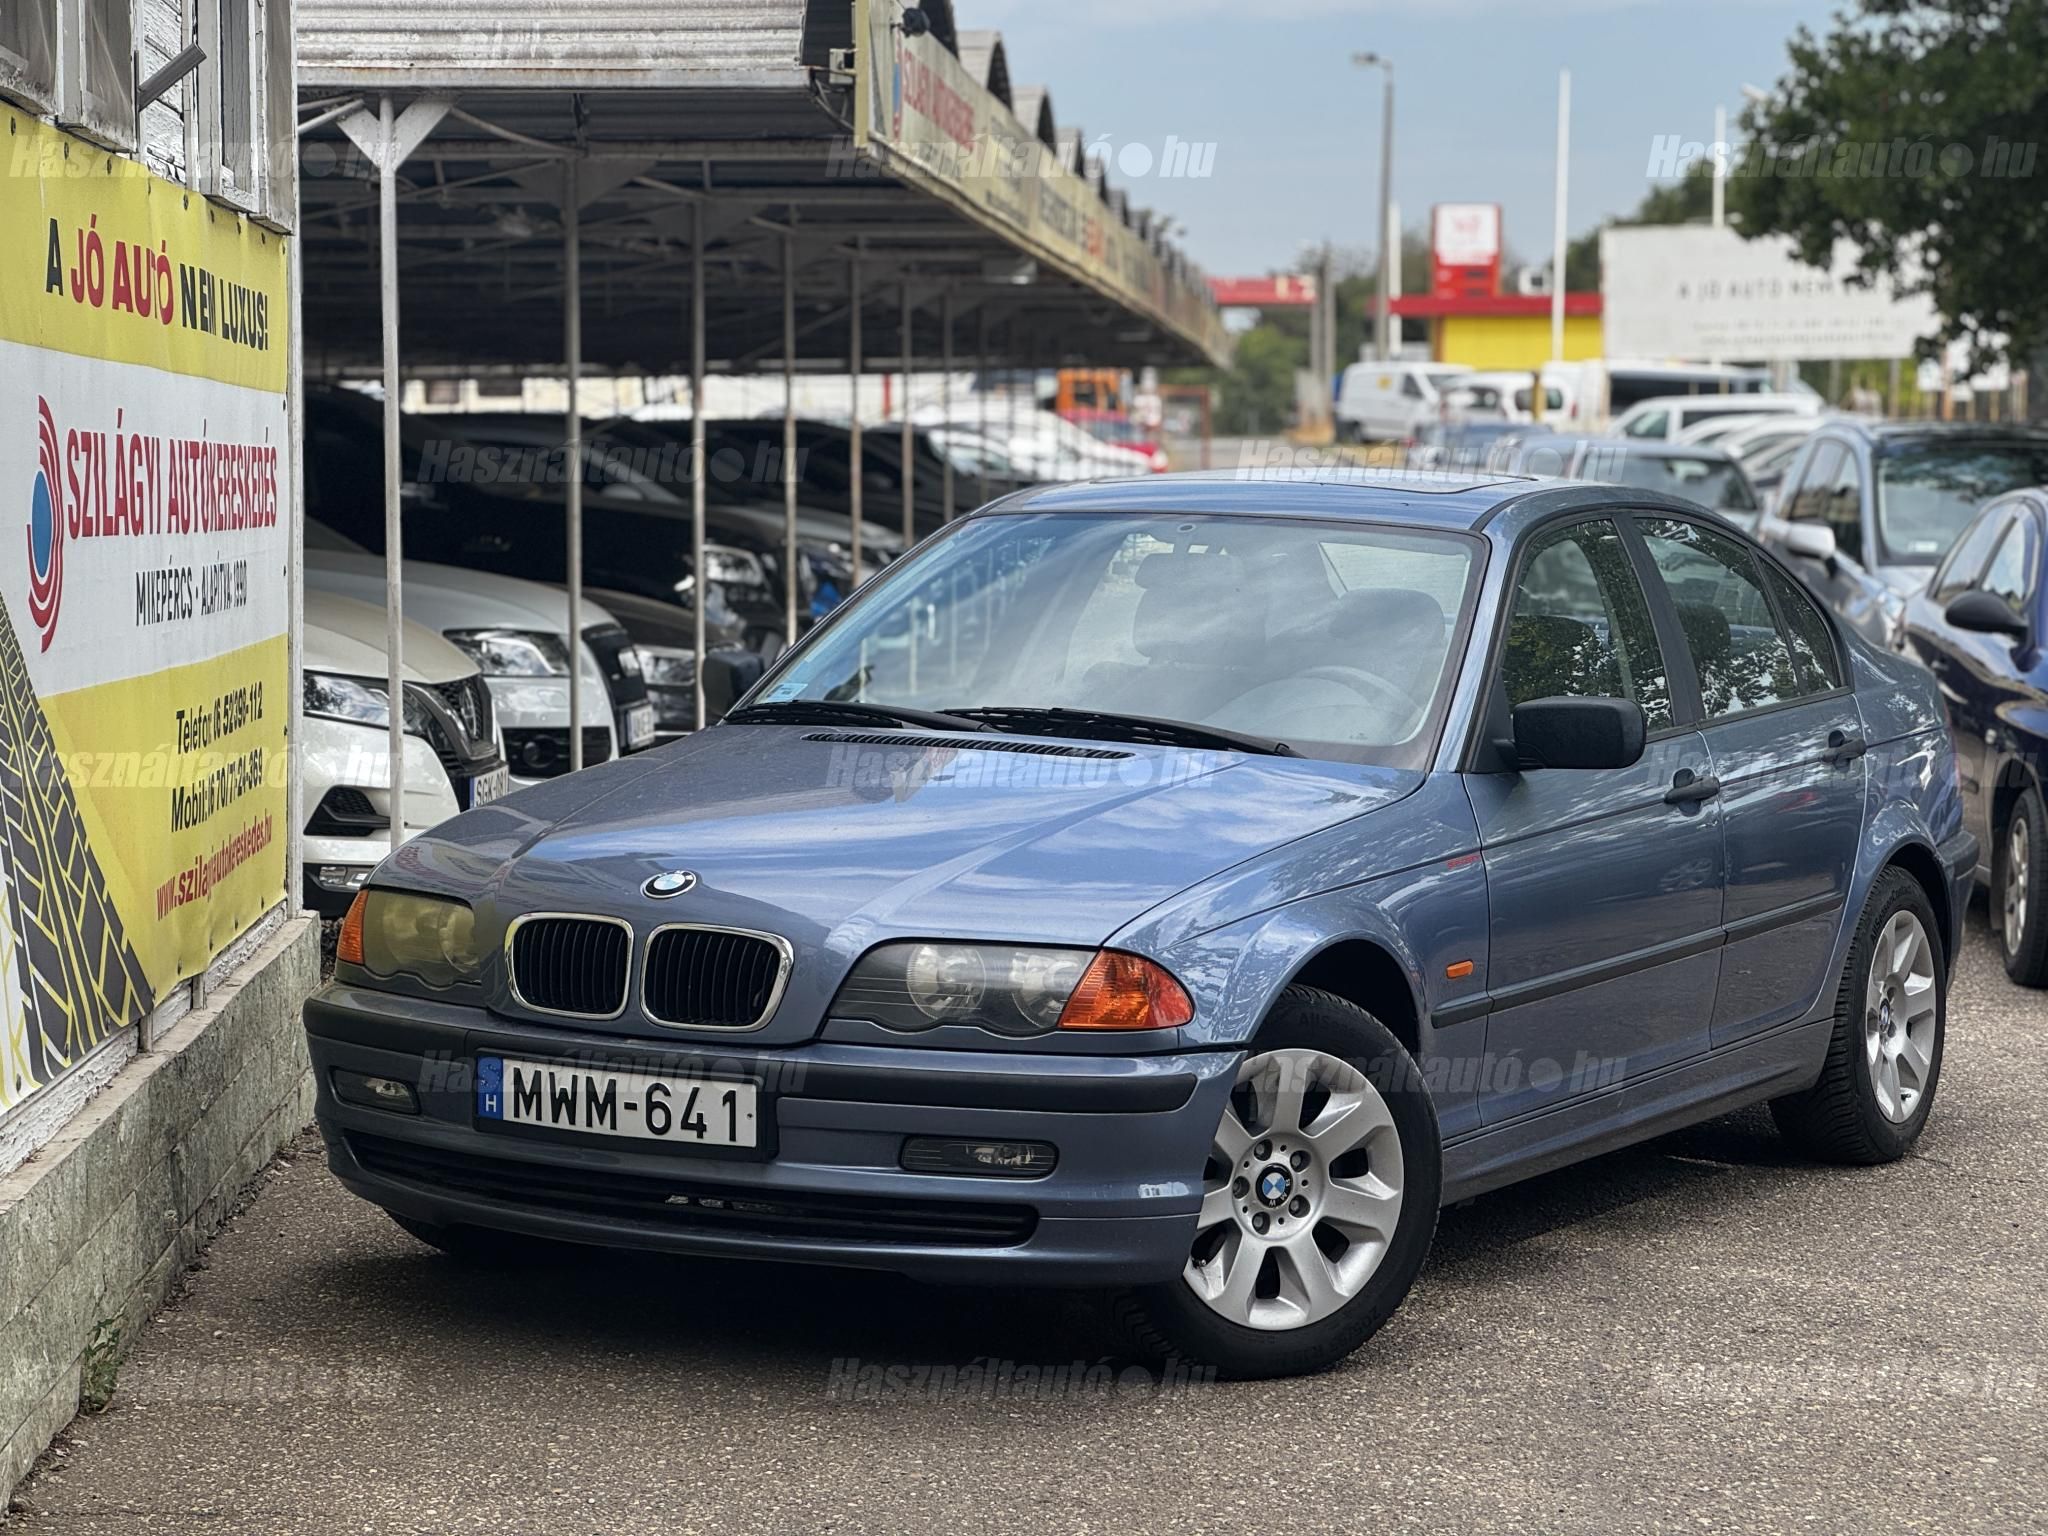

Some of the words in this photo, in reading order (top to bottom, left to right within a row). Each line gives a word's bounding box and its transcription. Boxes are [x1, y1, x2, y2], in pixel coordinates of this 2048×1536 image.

[46, 218, 63, 296] A
[71, 214, 104, 308] JÓ
[220, 278, 268, 351] LUXUS!
[67, 408, 161, 540] SZILÁGYI
[167, 418, 277, 535] AUTÓKERESKEDÉS
[136, 554, 192, 627] MIKEPÉRCS
[171, 779, 207, 833] Mobil:
[485, 1093, 497, 1113] H
[513, 1067, 738, 1143] MWM-641
